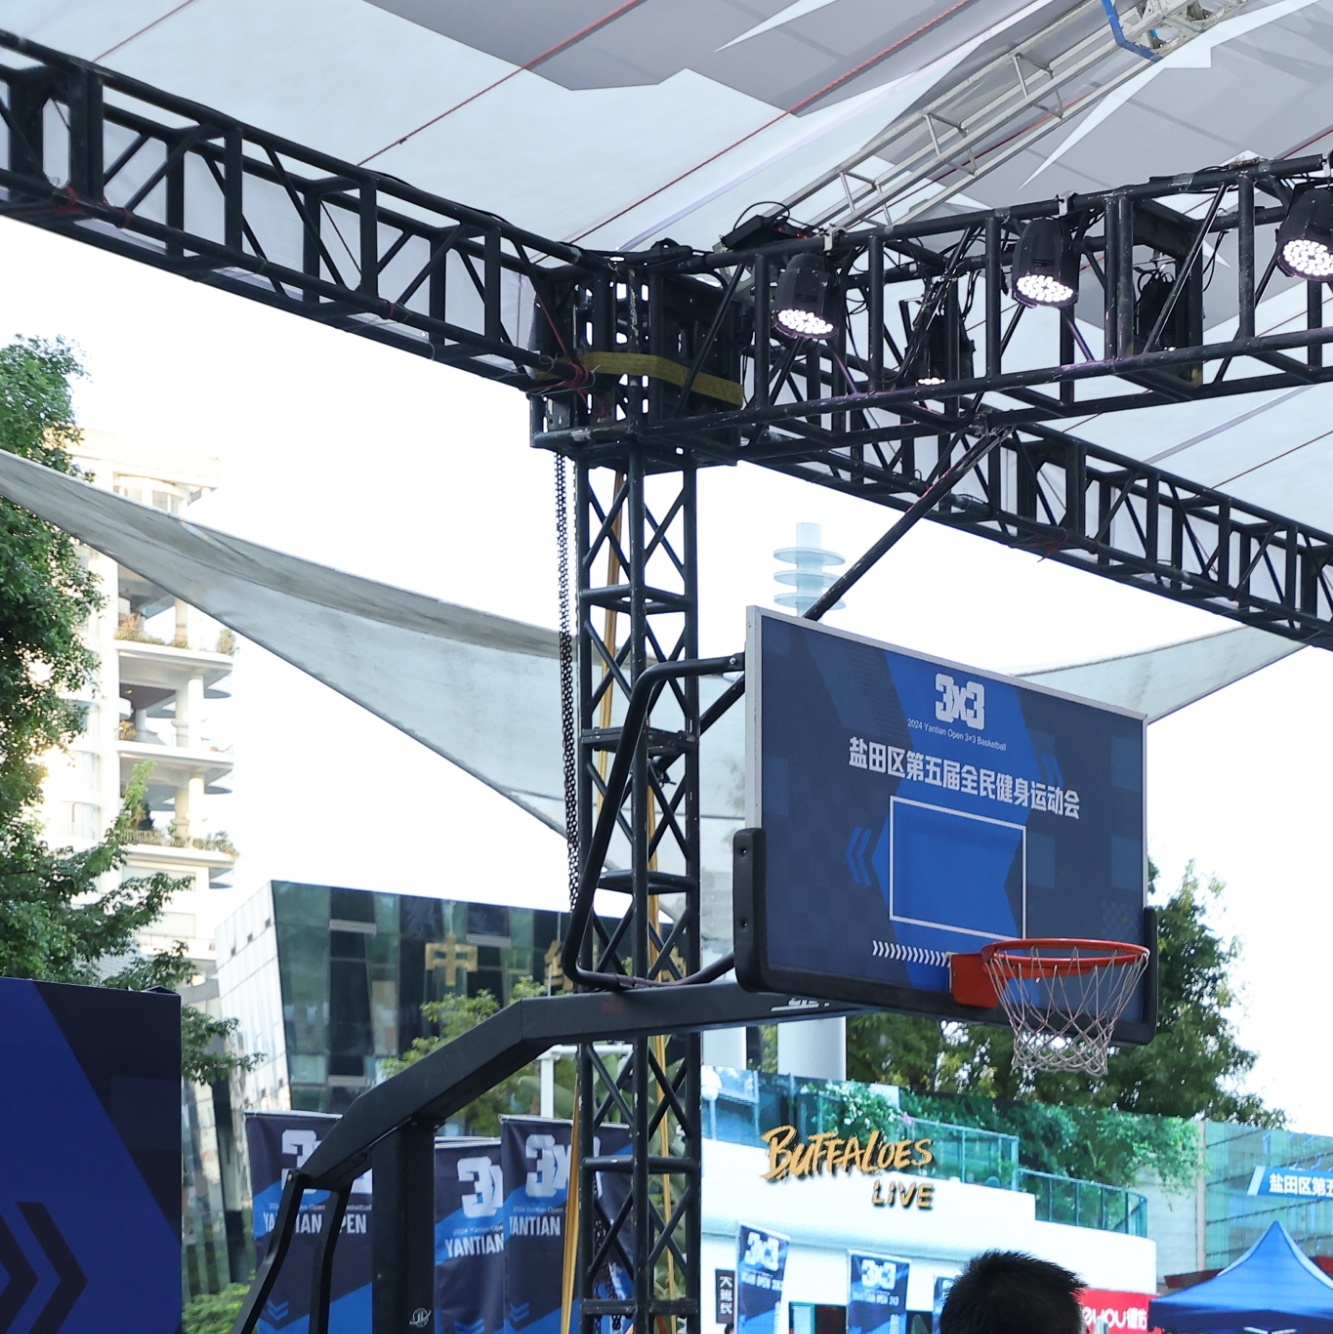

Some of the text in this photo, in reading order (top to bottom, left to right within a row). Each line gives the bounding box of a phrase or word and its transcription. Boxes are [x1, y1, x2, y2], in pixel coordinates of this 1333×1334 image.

[907, 718, 923, 731] 2024
[924, 722, 946, 737] Yantian
[948, 728, 964, 741] Open
[977, 735, 1006, 751] Basketball
[849, 736, 1080, 819] 盐田区第五届全民健身运动会
[872, 1180, 934, 1208] LIVE
